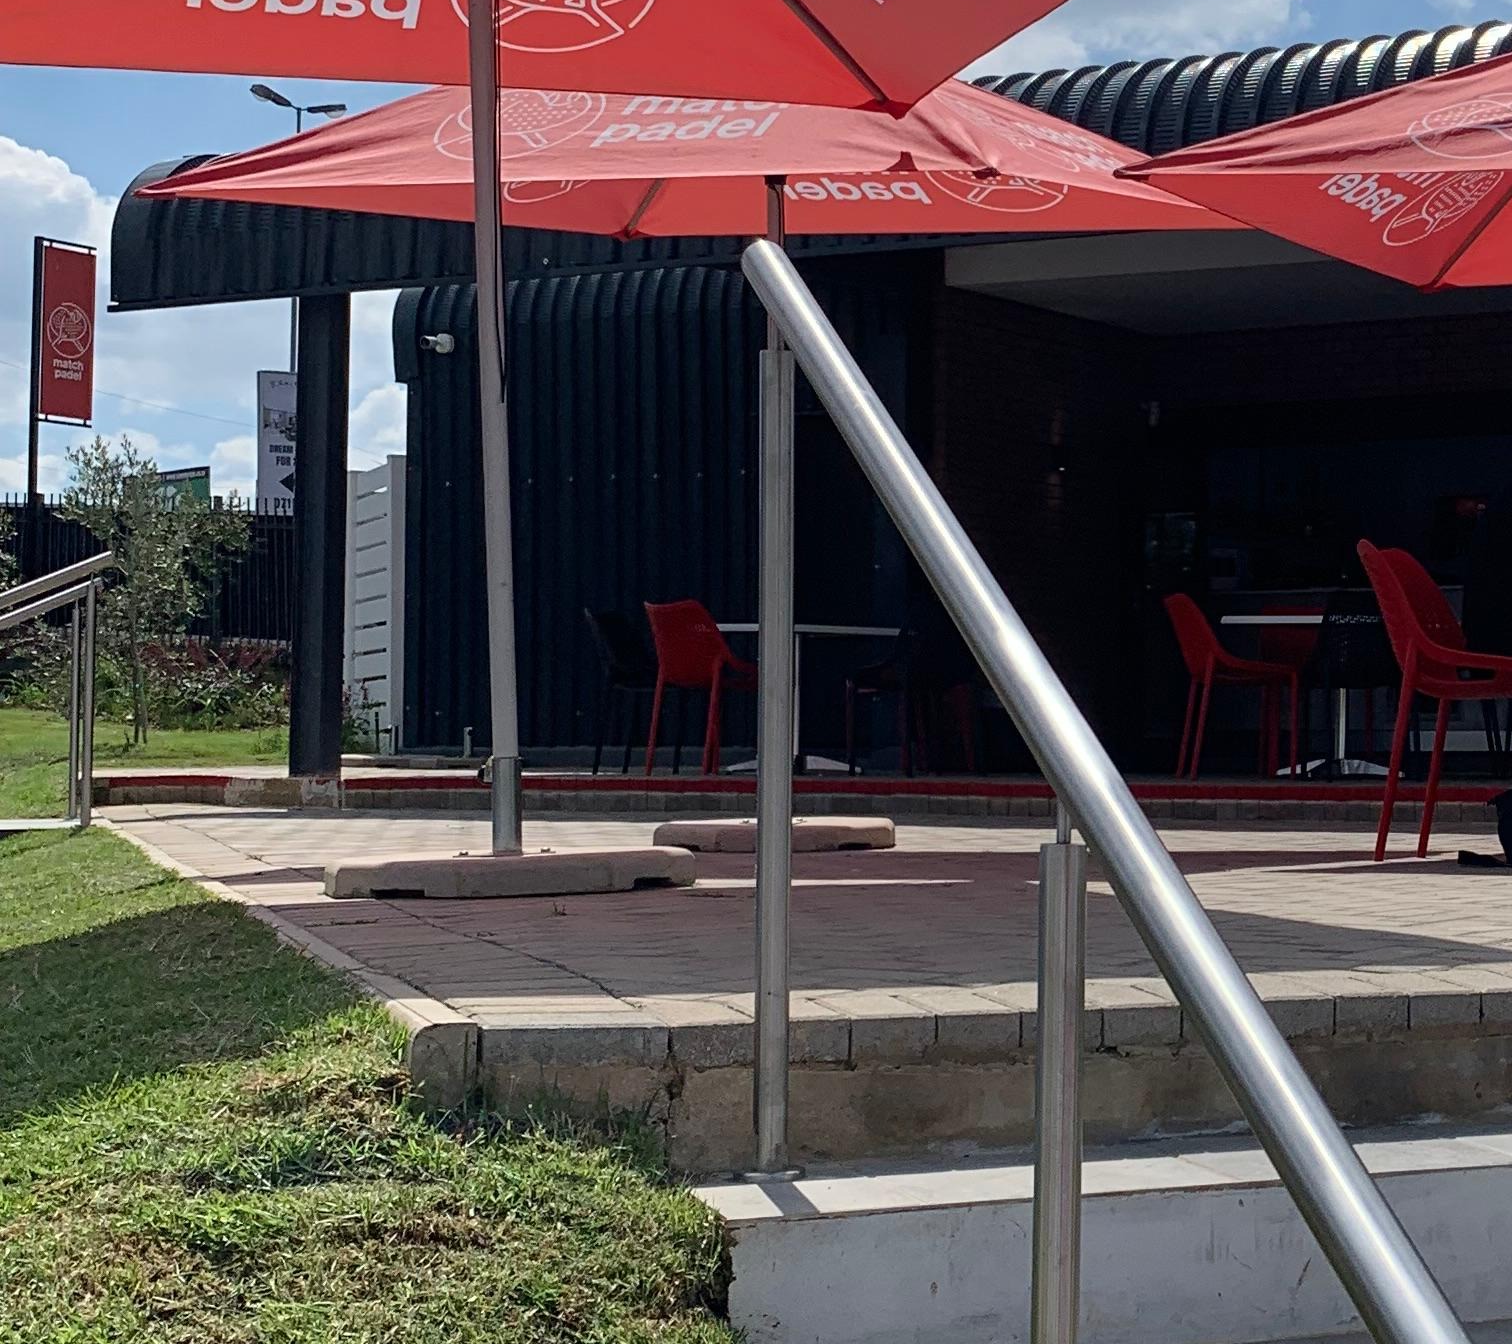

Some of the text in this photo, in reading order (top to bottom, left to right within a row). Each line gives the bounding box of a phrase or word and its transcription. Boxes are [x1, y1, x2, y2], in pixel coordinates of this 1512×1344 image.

[589, 111, 780, 148] padel
[53, 358, 84, 371] match
[54, 369, 82, 381] padel
